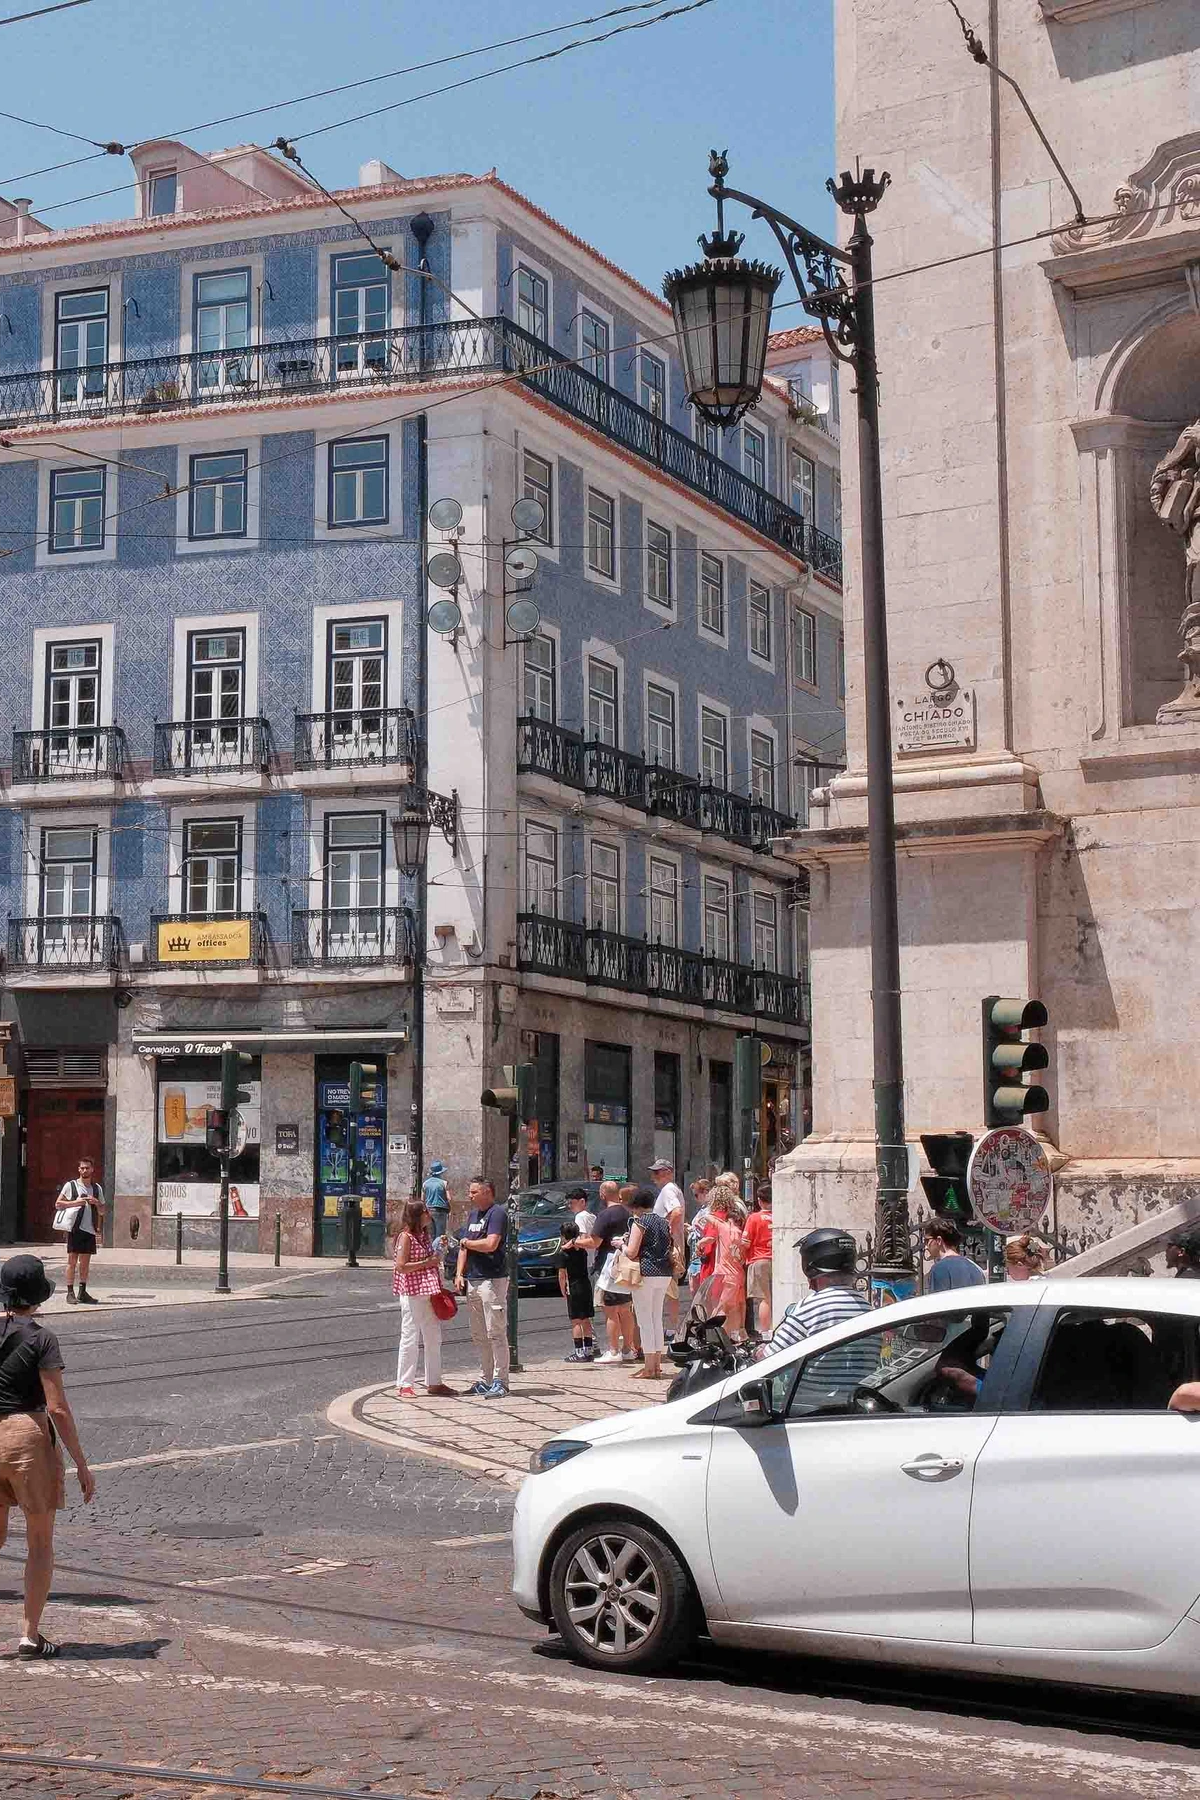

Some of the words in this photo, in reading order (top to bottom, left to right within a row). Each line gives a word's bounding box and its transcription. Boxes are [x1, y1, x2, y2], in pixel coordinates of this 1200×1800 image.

[914, 694, 952, 705] LARGO
[903, 707, 964, 722] CHIADO
[197, 939, 227, 947] offices
[138, 1045, 181, 1054] Cervejaria
[184, 1043, 194, 1054] O
[194, 1043, 223, 1054] Trevo
[159, 1184, 187, 1199] SOMOS
